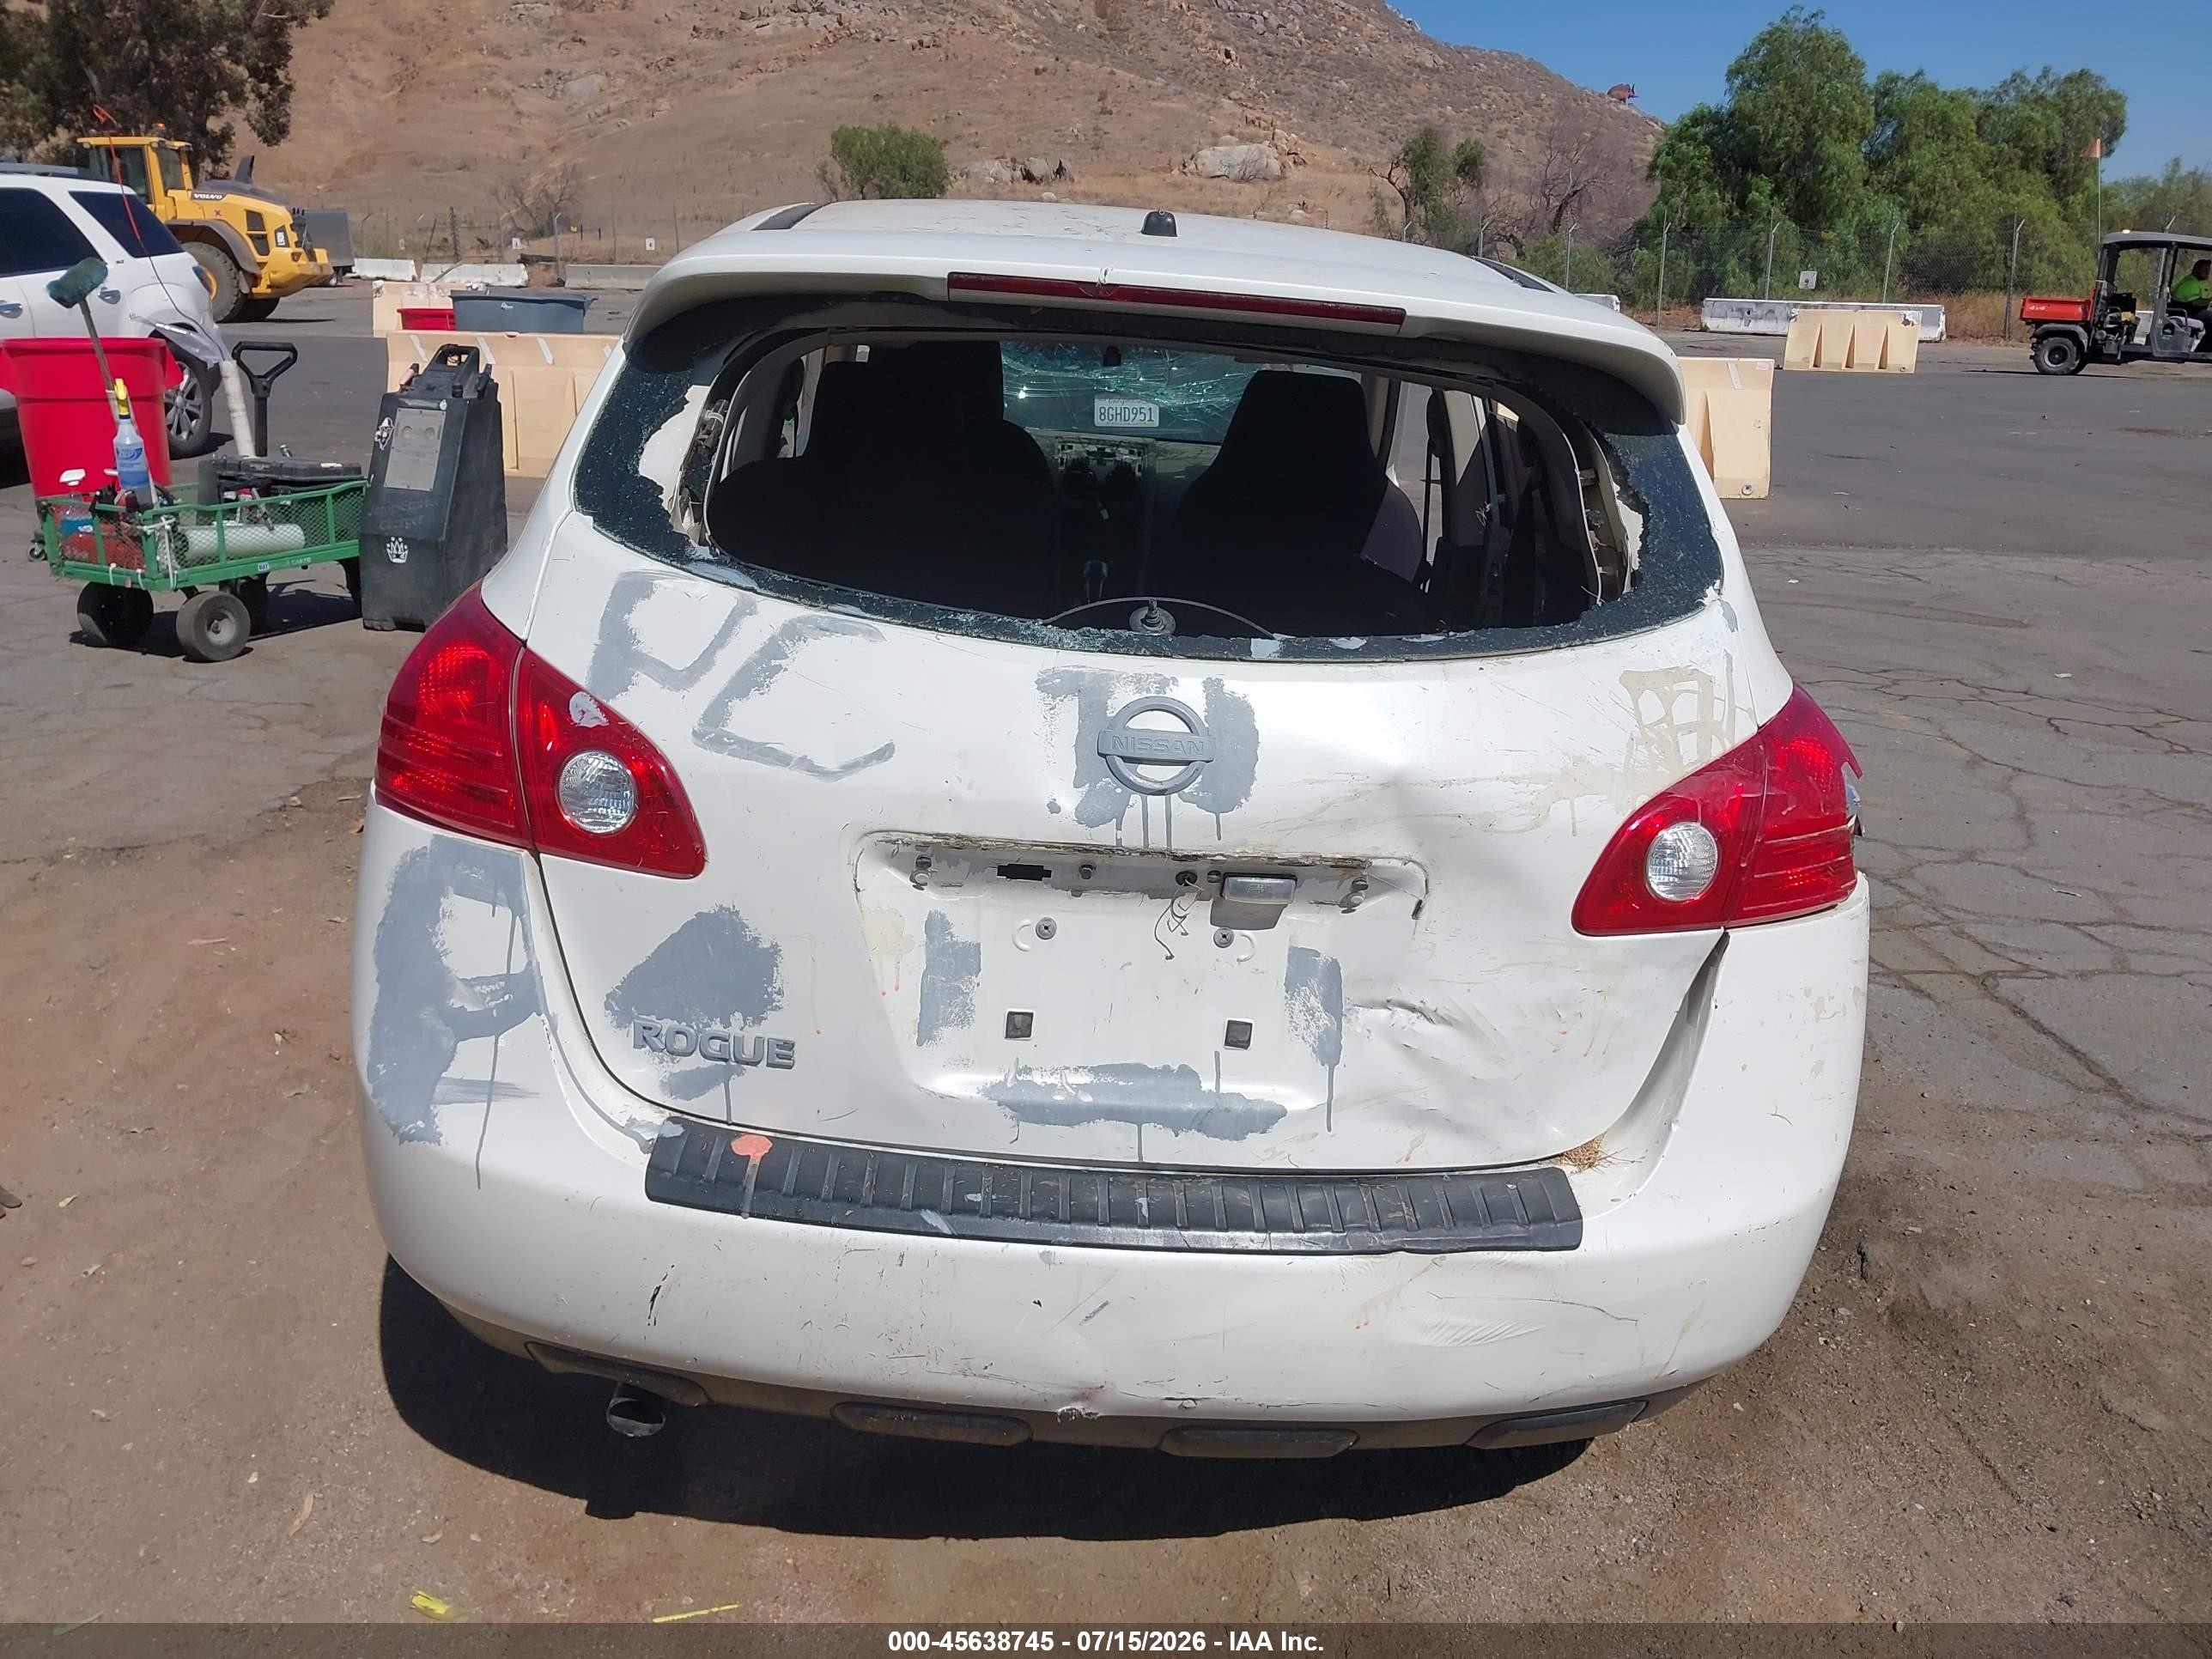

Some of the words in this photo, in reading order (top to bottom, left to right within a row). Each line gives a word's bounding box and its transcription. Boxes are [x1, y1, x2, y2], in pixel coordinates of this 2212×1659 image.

[1099, 406, 1154, 422] 8GHD951
[1111, 736, 1204, 756] NISSAN
[633, 1018, 795, 1069] ROGUE
